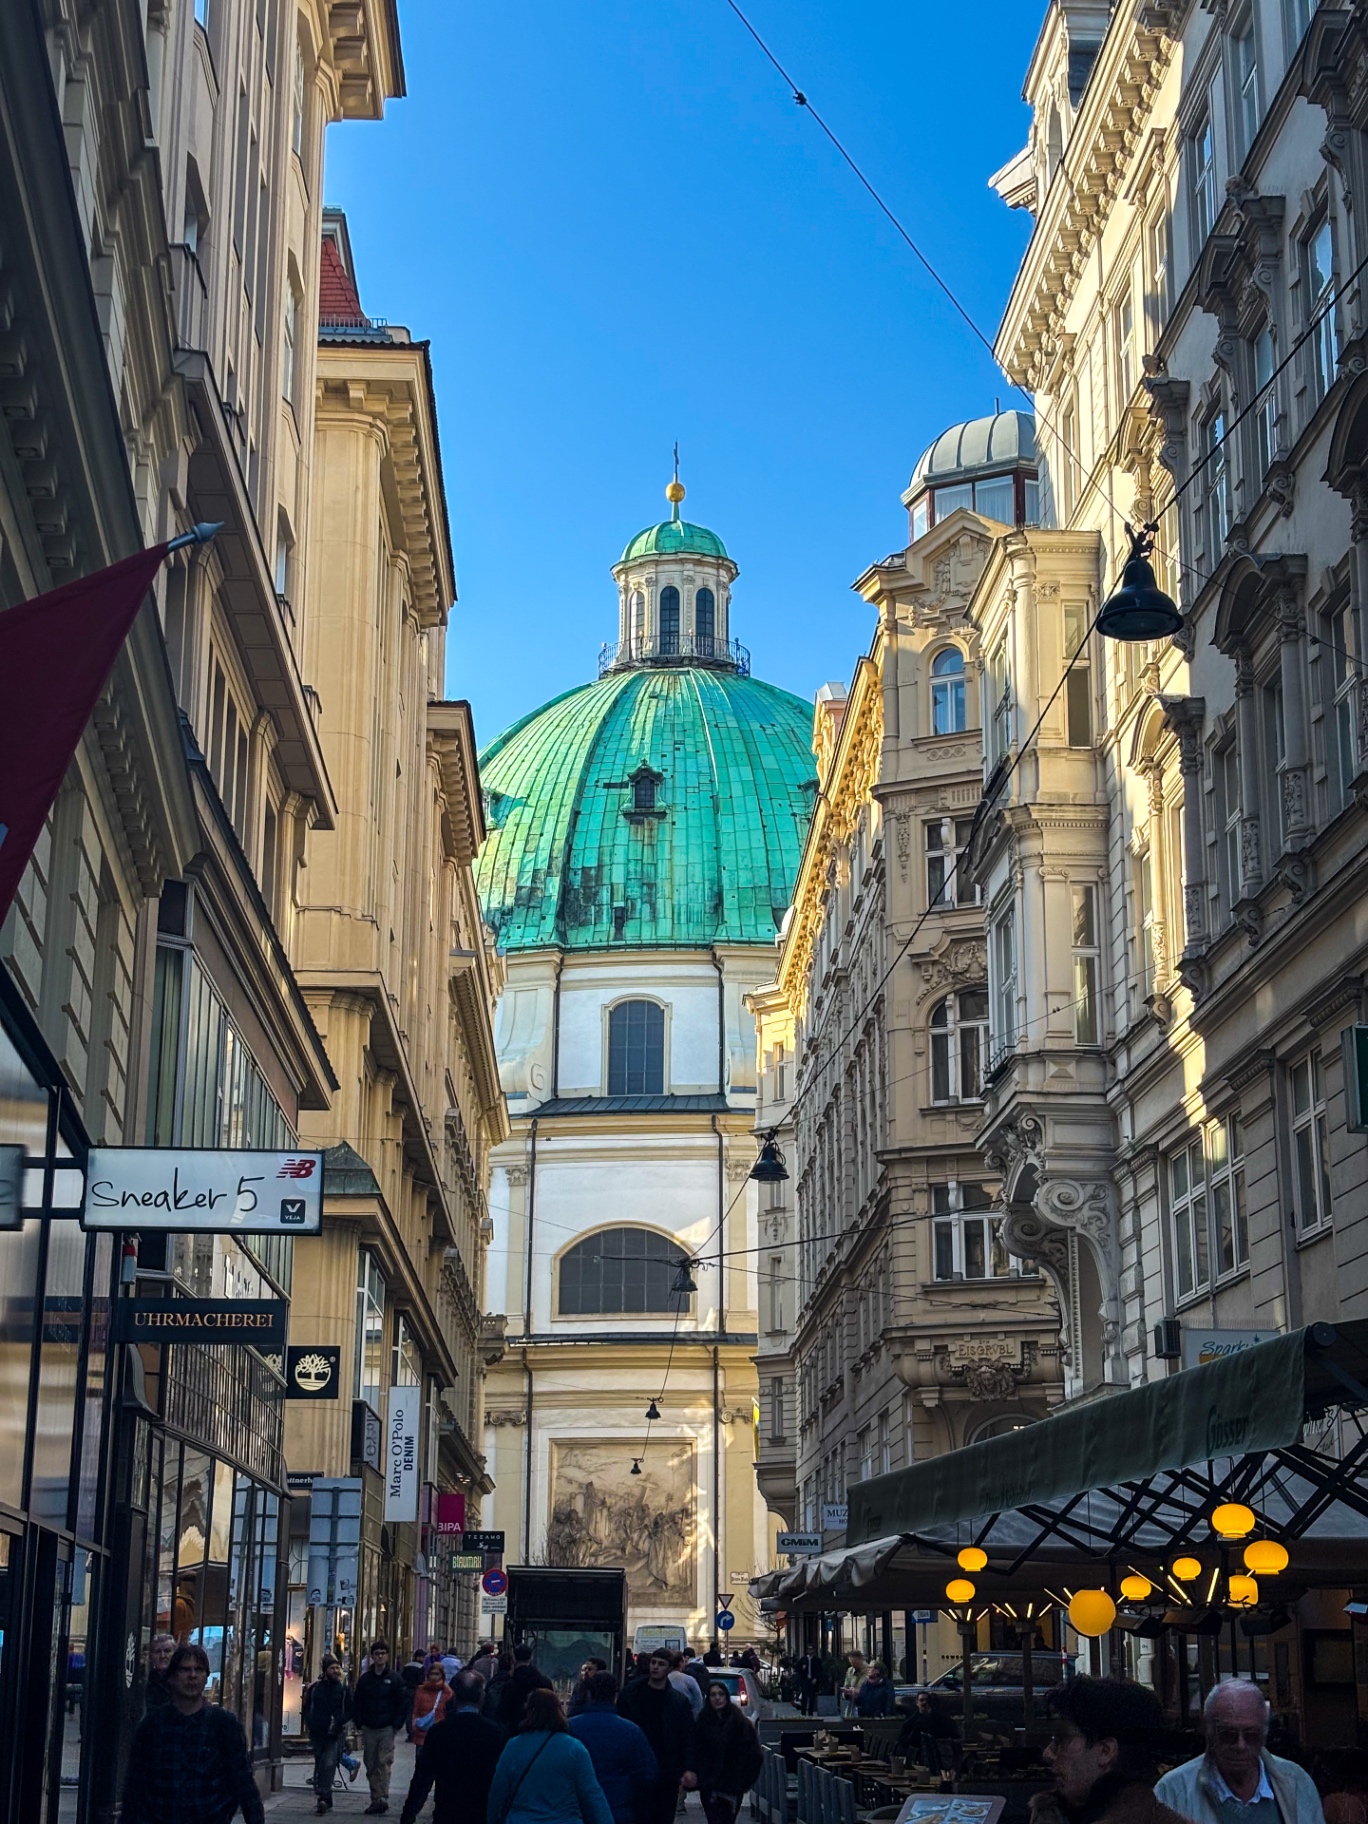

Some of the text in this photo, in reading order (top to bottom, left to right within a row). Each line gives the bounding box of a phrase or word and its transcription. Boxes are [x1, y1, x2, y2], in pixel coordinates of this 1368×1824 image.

[91, 1166, 265, 1213] Sneaker 5
[134, 1312, 275, 1328] UHRMACHEREI
[1199, 1339, 1254, 1359] Spark
[403, 1436, 415, 1471] DENIM
[389, 1459, 402, 1499] Marc
[438, 1522, 462, 1532] BIPA
